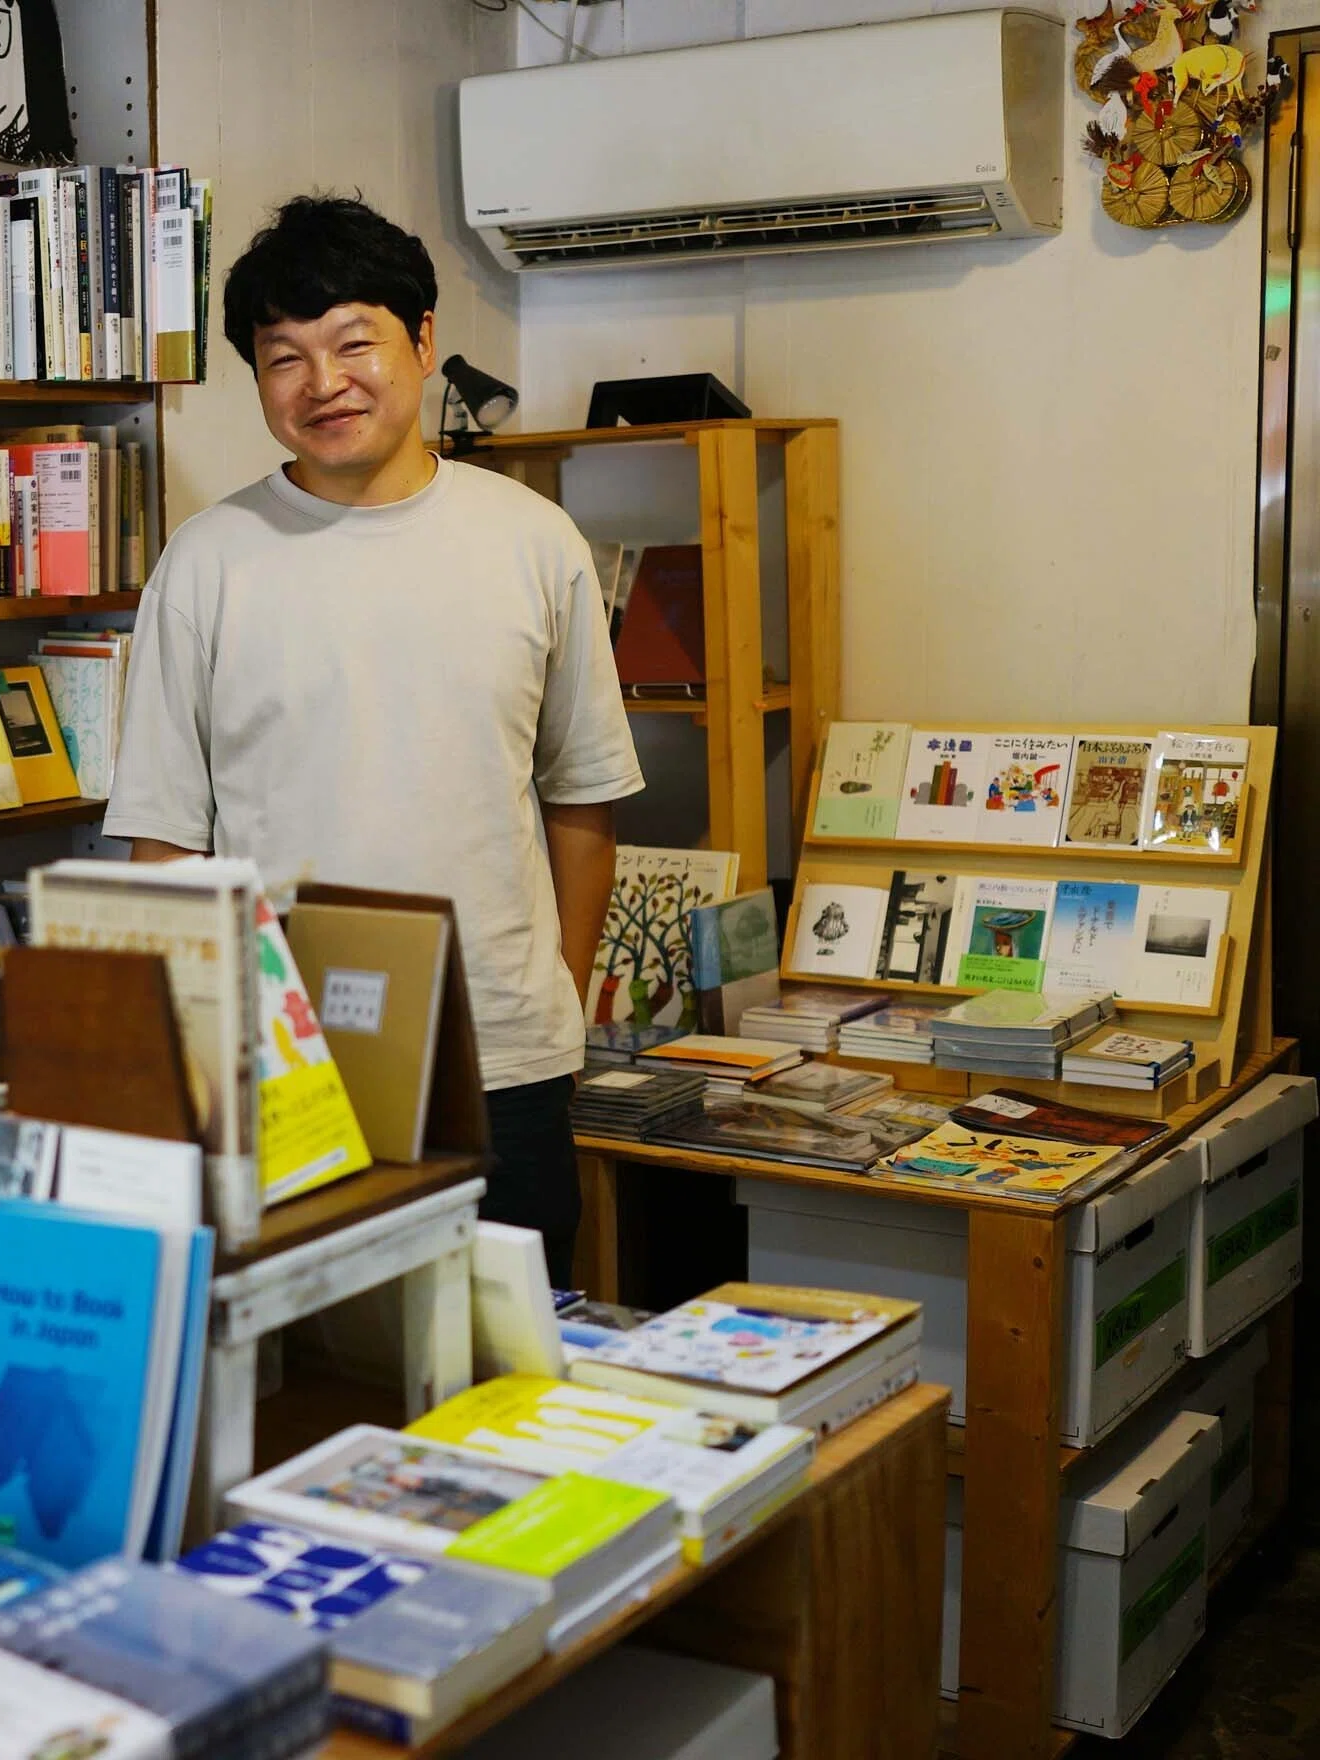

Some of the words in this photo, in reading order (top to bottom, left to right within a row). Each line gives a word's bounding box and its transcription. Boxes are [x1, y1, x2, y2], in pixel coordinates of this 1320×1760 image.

[993, 737, 1069, 751] ここに住みたい
[1082, 741, 1149, 755] 日本ぶらりぶらり
[42, 1286, 65, 1314] to
[72, 1290, 125, 1321] Book
[34, 1318, 100, 1351] Japan
